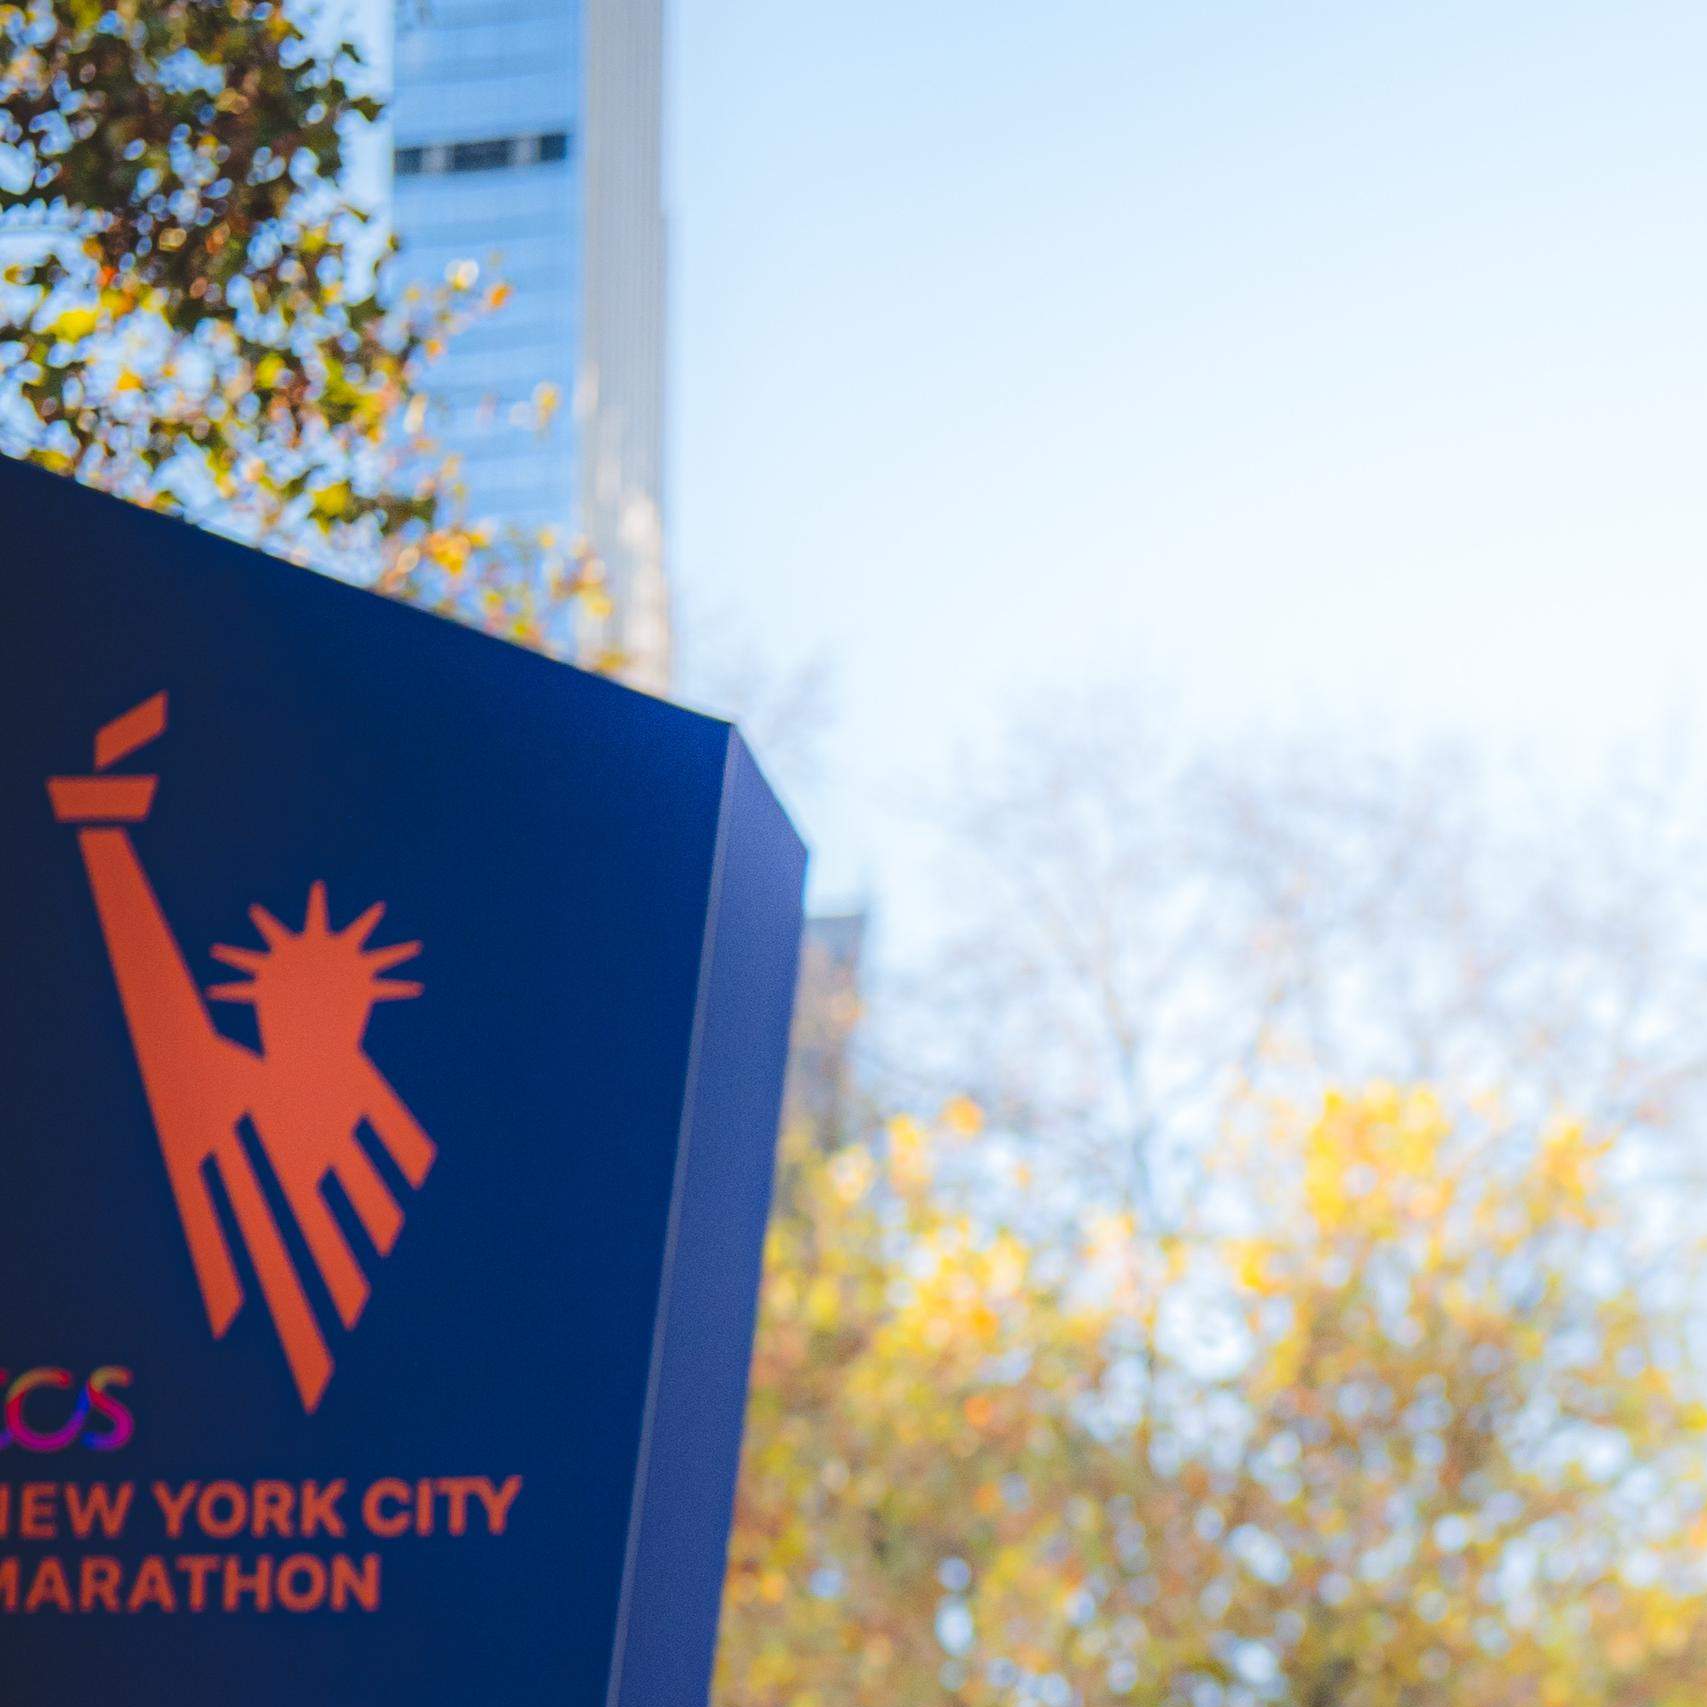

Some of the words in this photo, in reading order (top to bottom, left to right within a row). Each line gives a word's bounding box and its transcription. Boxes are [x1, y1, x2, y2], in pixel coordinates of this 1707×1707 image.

[0, 1366, 135, 1452] cs
[0, 1481, 135, 1540] EW
[151, 1478, 347, 1539] YORK
[364, 1475, 521, 1538] CITY
